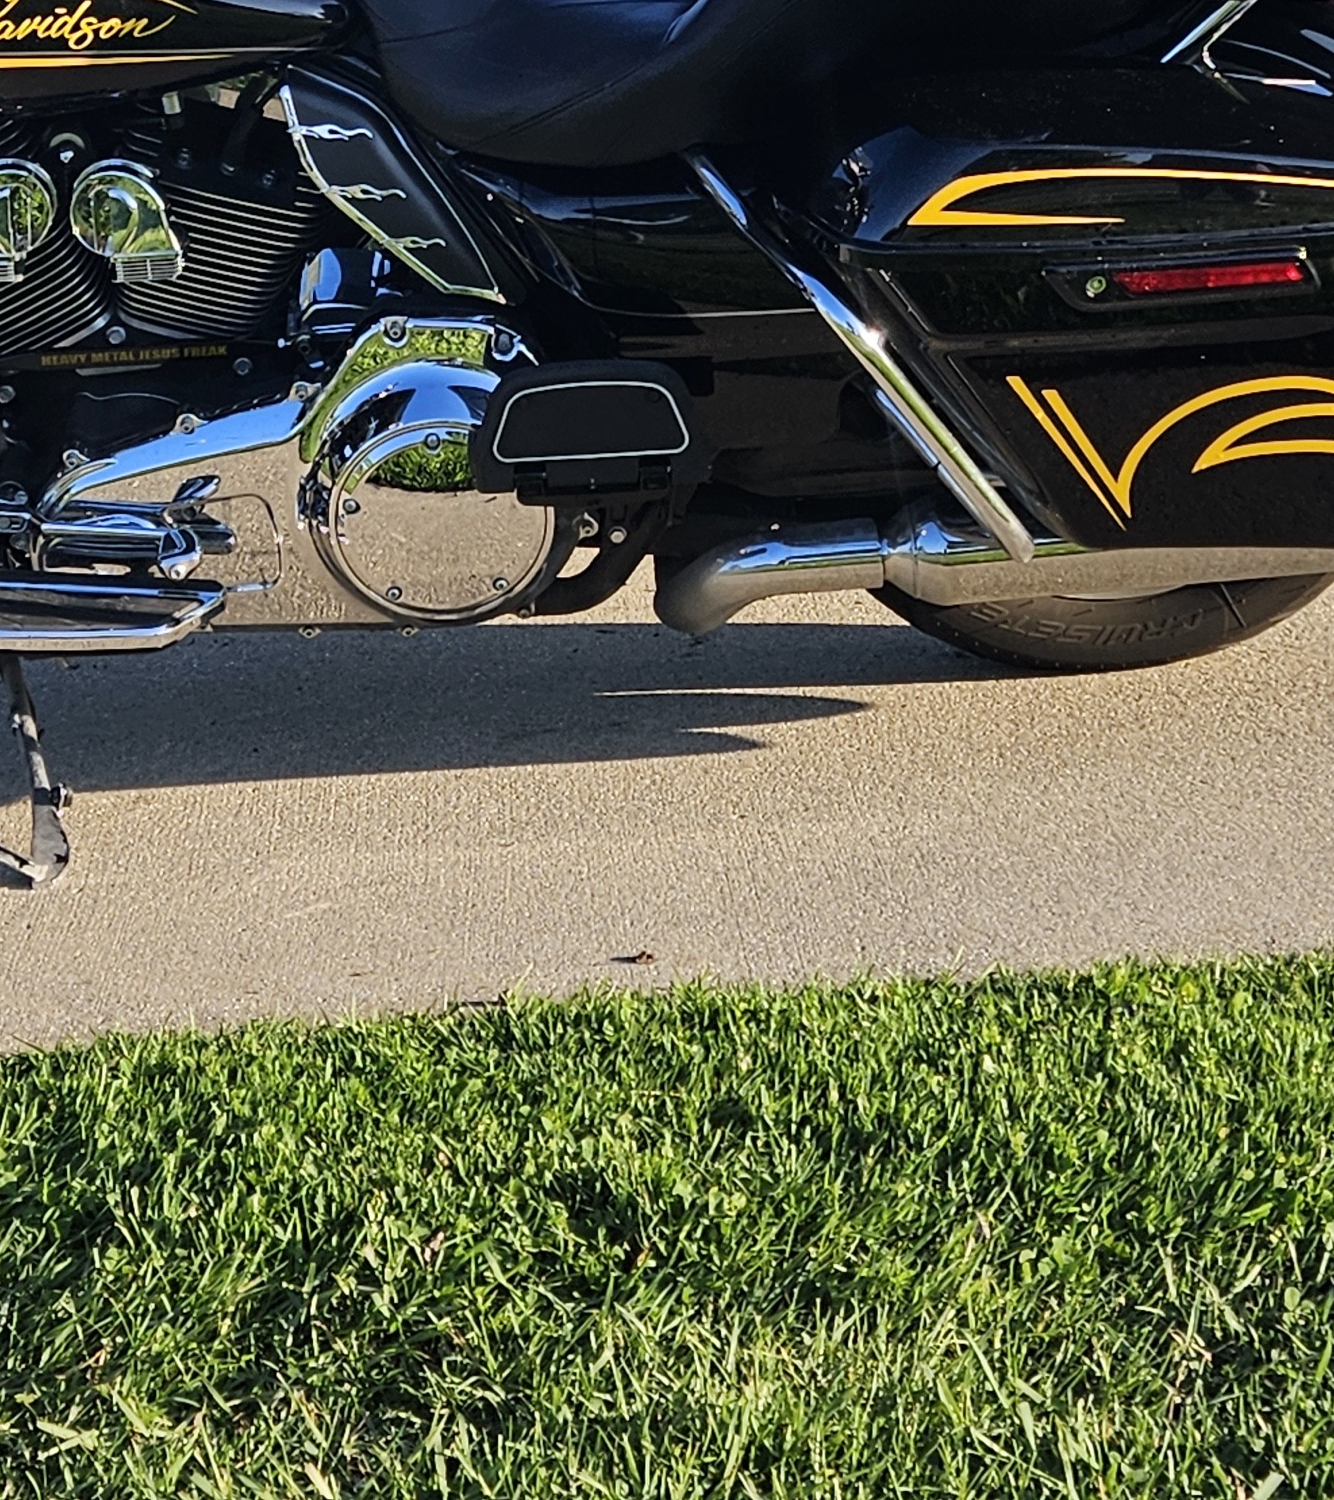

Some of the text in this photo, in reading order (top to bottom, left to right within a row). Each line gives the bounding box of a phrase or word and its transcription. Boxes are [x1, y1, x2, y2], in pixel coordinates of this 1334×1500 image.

[40, 345, 228, 367] HEAVY METAL JESUS FREAK
